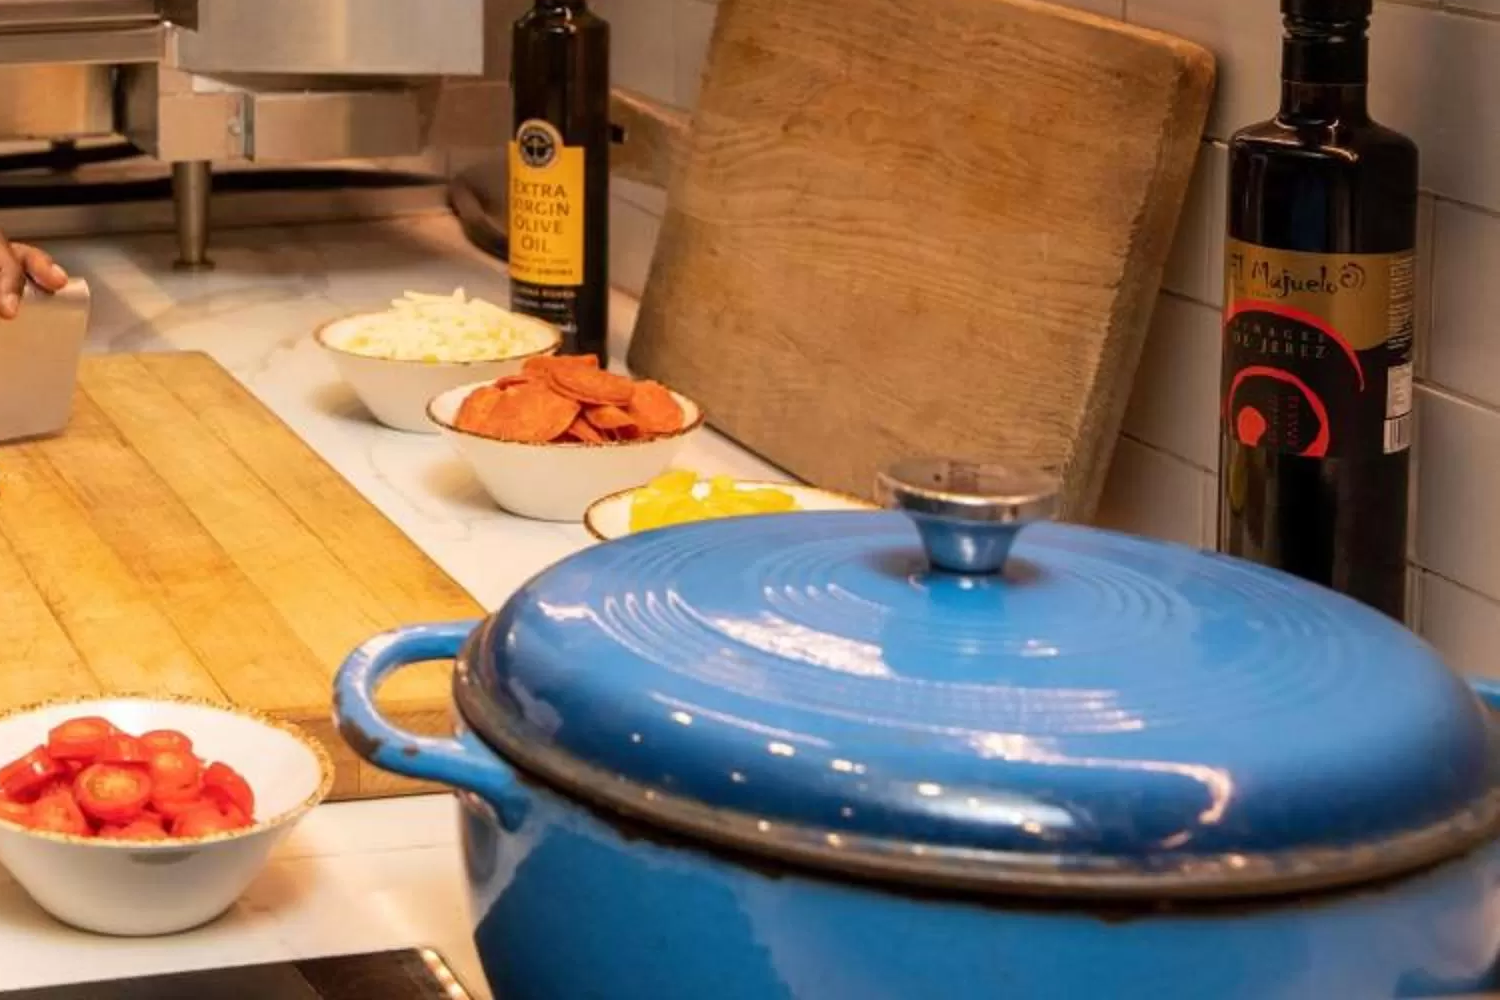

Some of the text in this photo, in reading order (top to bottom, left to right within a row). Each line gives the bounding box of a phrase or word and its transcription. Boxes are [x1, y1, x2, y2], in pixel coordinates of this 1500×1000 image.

[513, 177, 567, 199] EXTRA
[513, 215, 563, 234] OLIVE
[521, 233, 552, 252] OIL
[1251, 261, 1338, 297] Majuelo
